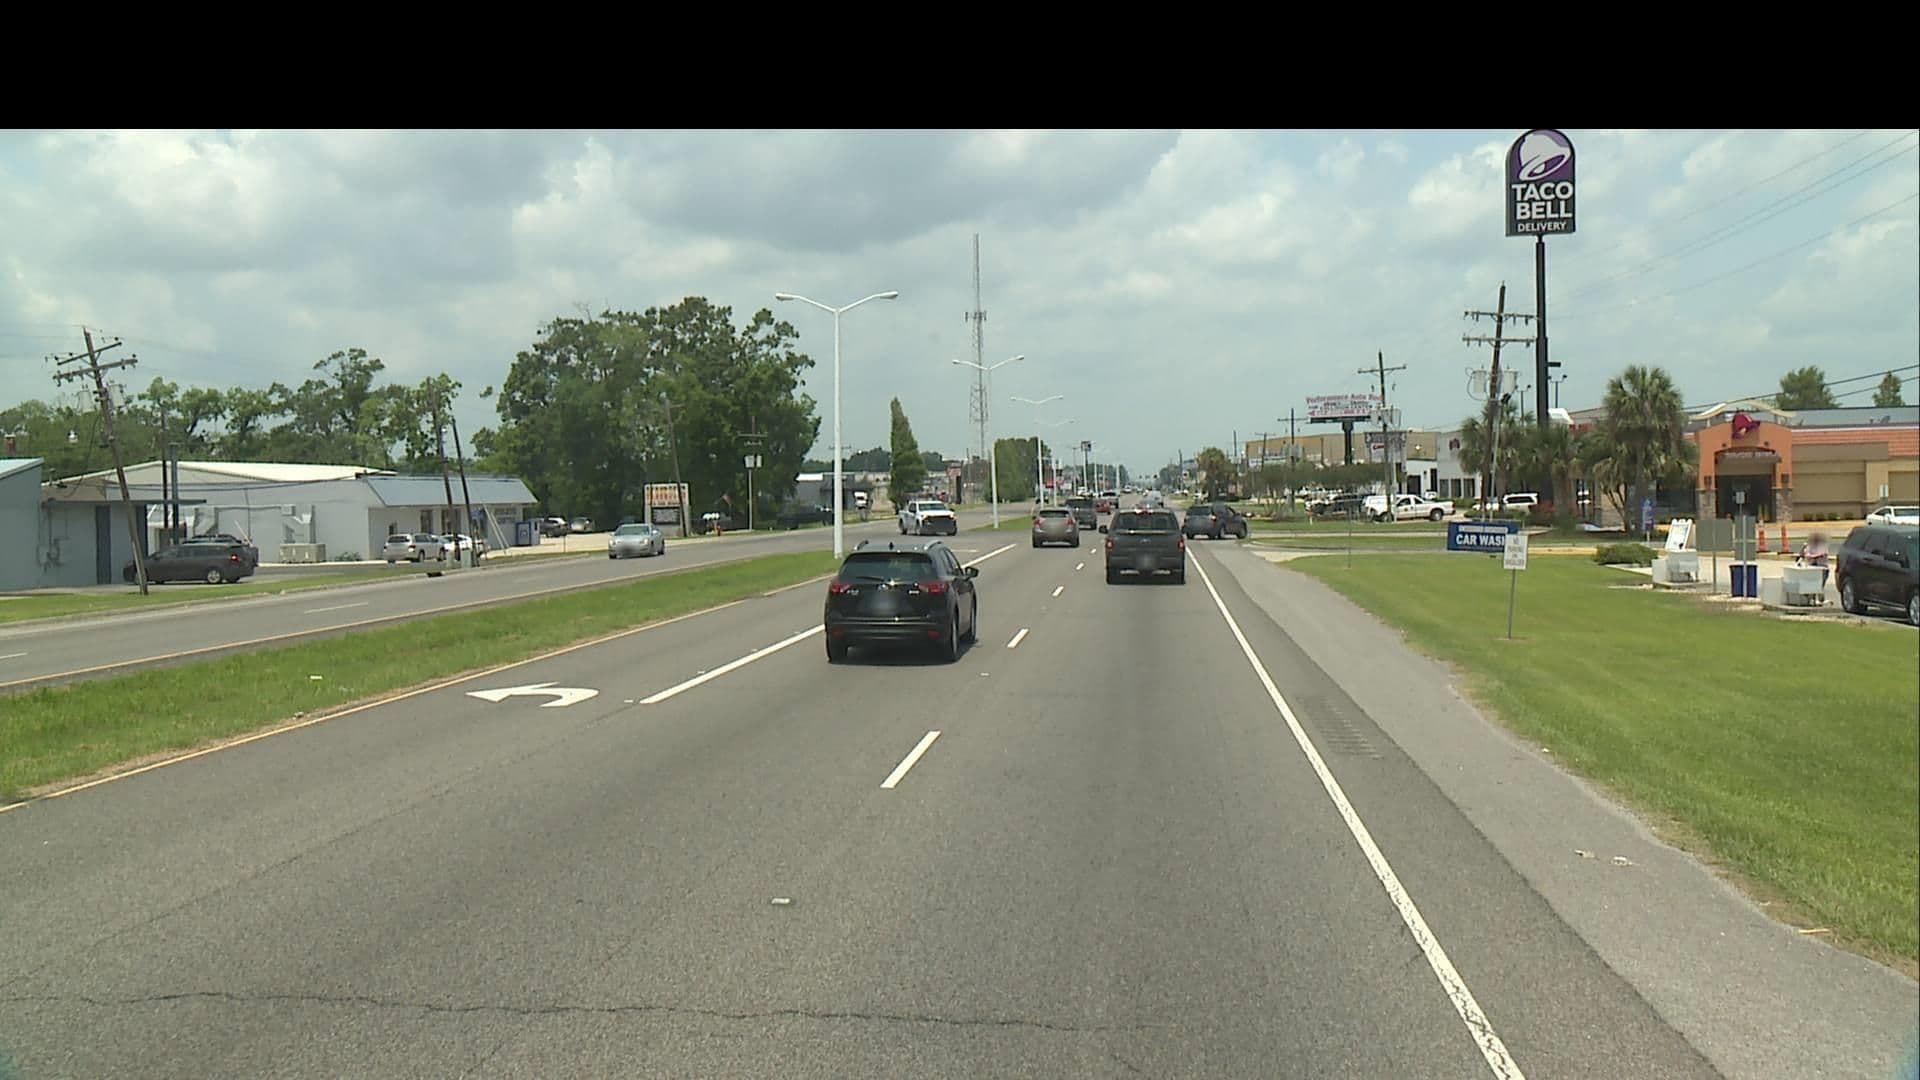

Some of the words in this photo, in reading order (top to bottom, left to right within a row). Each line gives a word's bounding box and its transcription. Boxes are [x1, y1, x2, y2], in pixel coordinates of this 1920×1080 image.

[1511, 182, 1574, 201] TACO
[1516, 200, 1573, 220] BELL
[1517, 221, 1567, 232] DELIVERY
[1456, 534, 1477, 545] CAR
